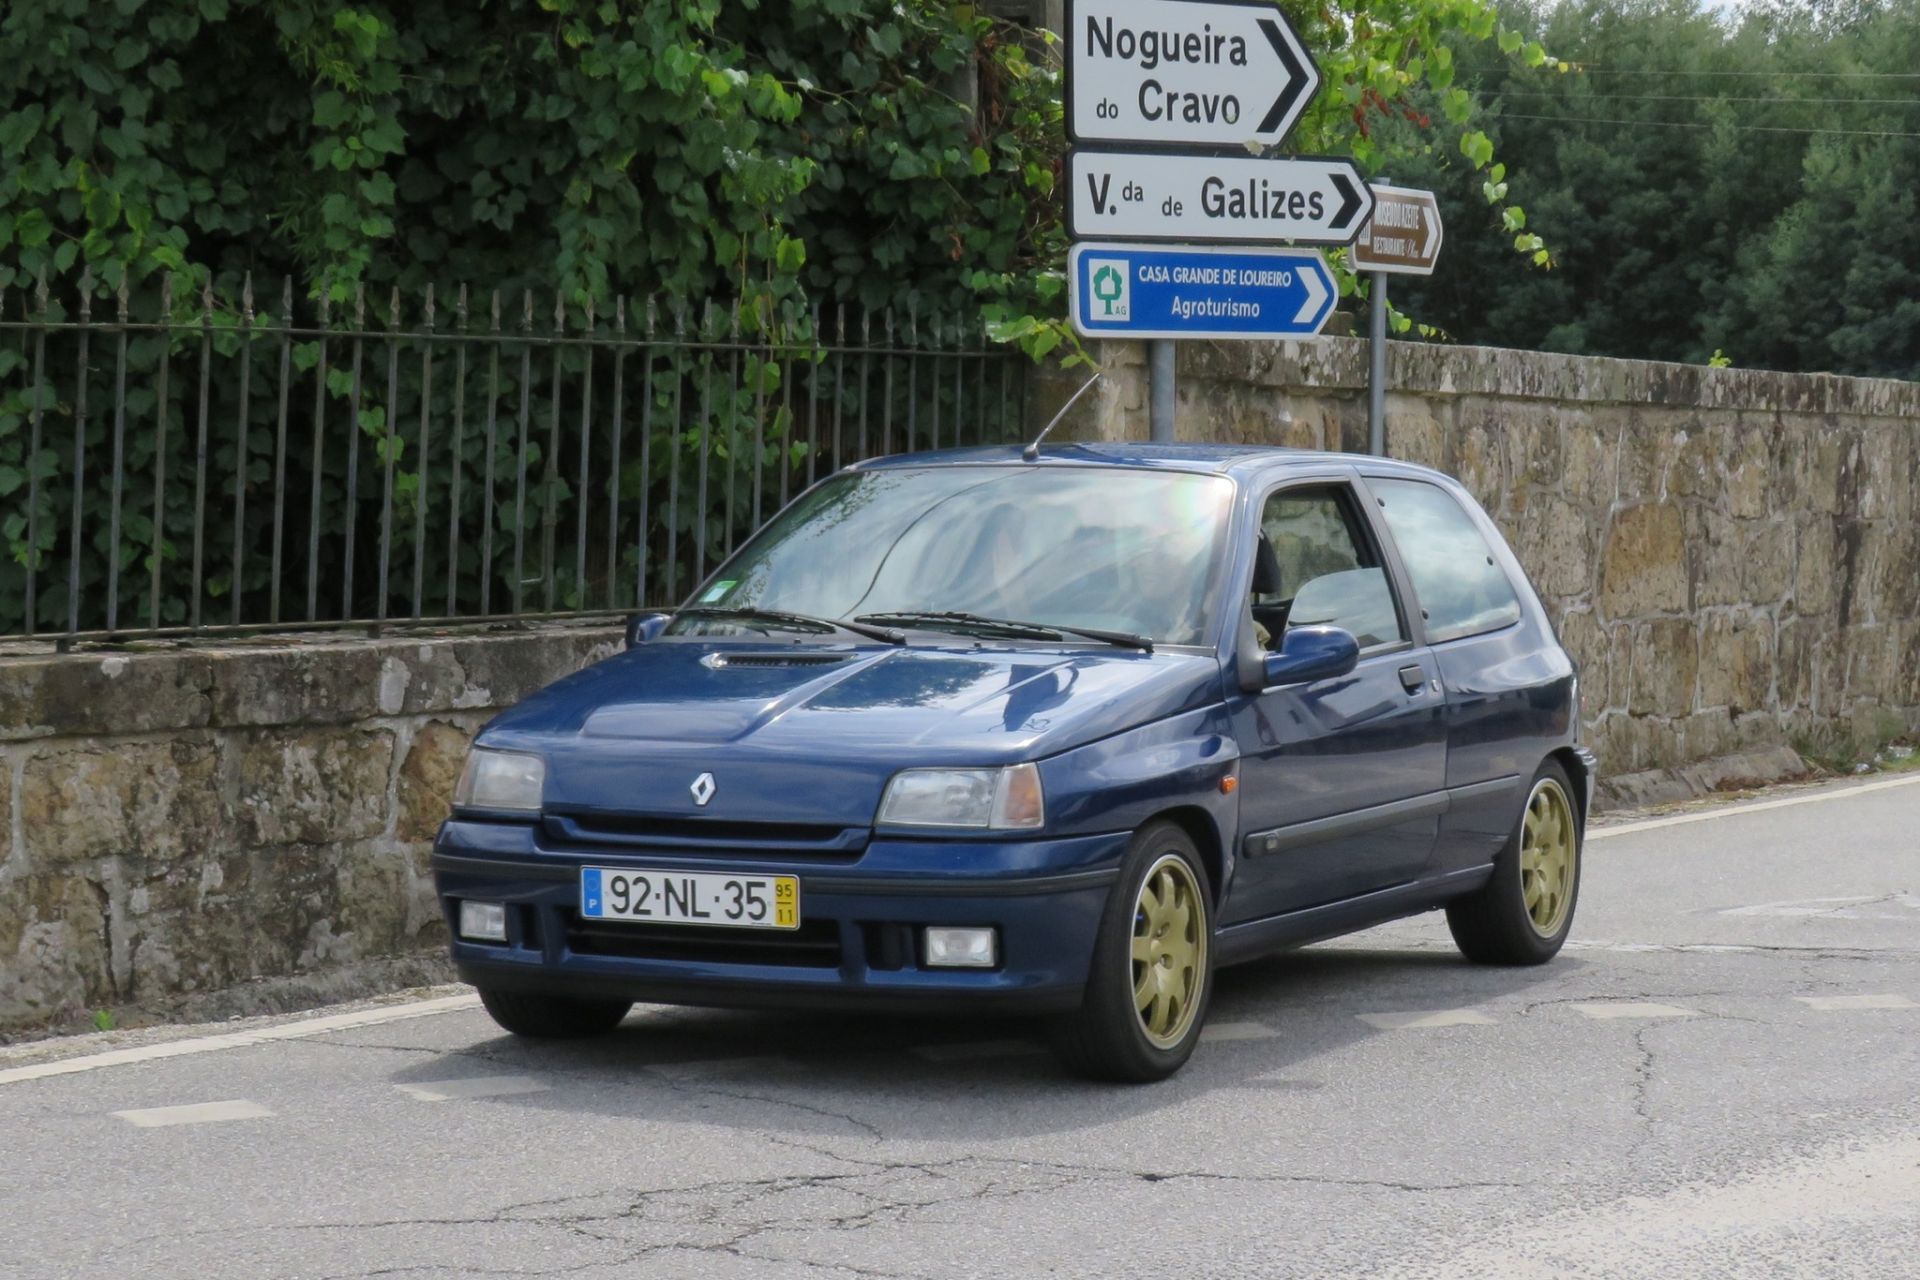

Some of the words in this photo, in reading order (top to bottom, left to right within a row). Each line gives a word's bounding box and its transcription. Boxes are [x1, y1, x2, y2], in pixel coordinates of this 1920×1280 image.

[1087, 15, 1247, 70] Nogueira
[1096, 98, 1119, 119] do
[1138, 79, 1240, 124] Cravo
[1161, 196, 1183, 216] de
[1201, 176, 1324, 221] Galizes
[1138, 265, 1171, 283] CASA
[1173, 268, 1220, 285] GRANDE
[1222, 270, 1236, 285] DE
[1239, 270, 1292, 287] LOUREIRO
[1115, 305, 1127, 316] AG
[1171, 296, 1260, 319] Agroturismo
[775, 884, 792, 898] 95
[588, 899, 597, 909] P
[778, 909, 793, 923] 11
